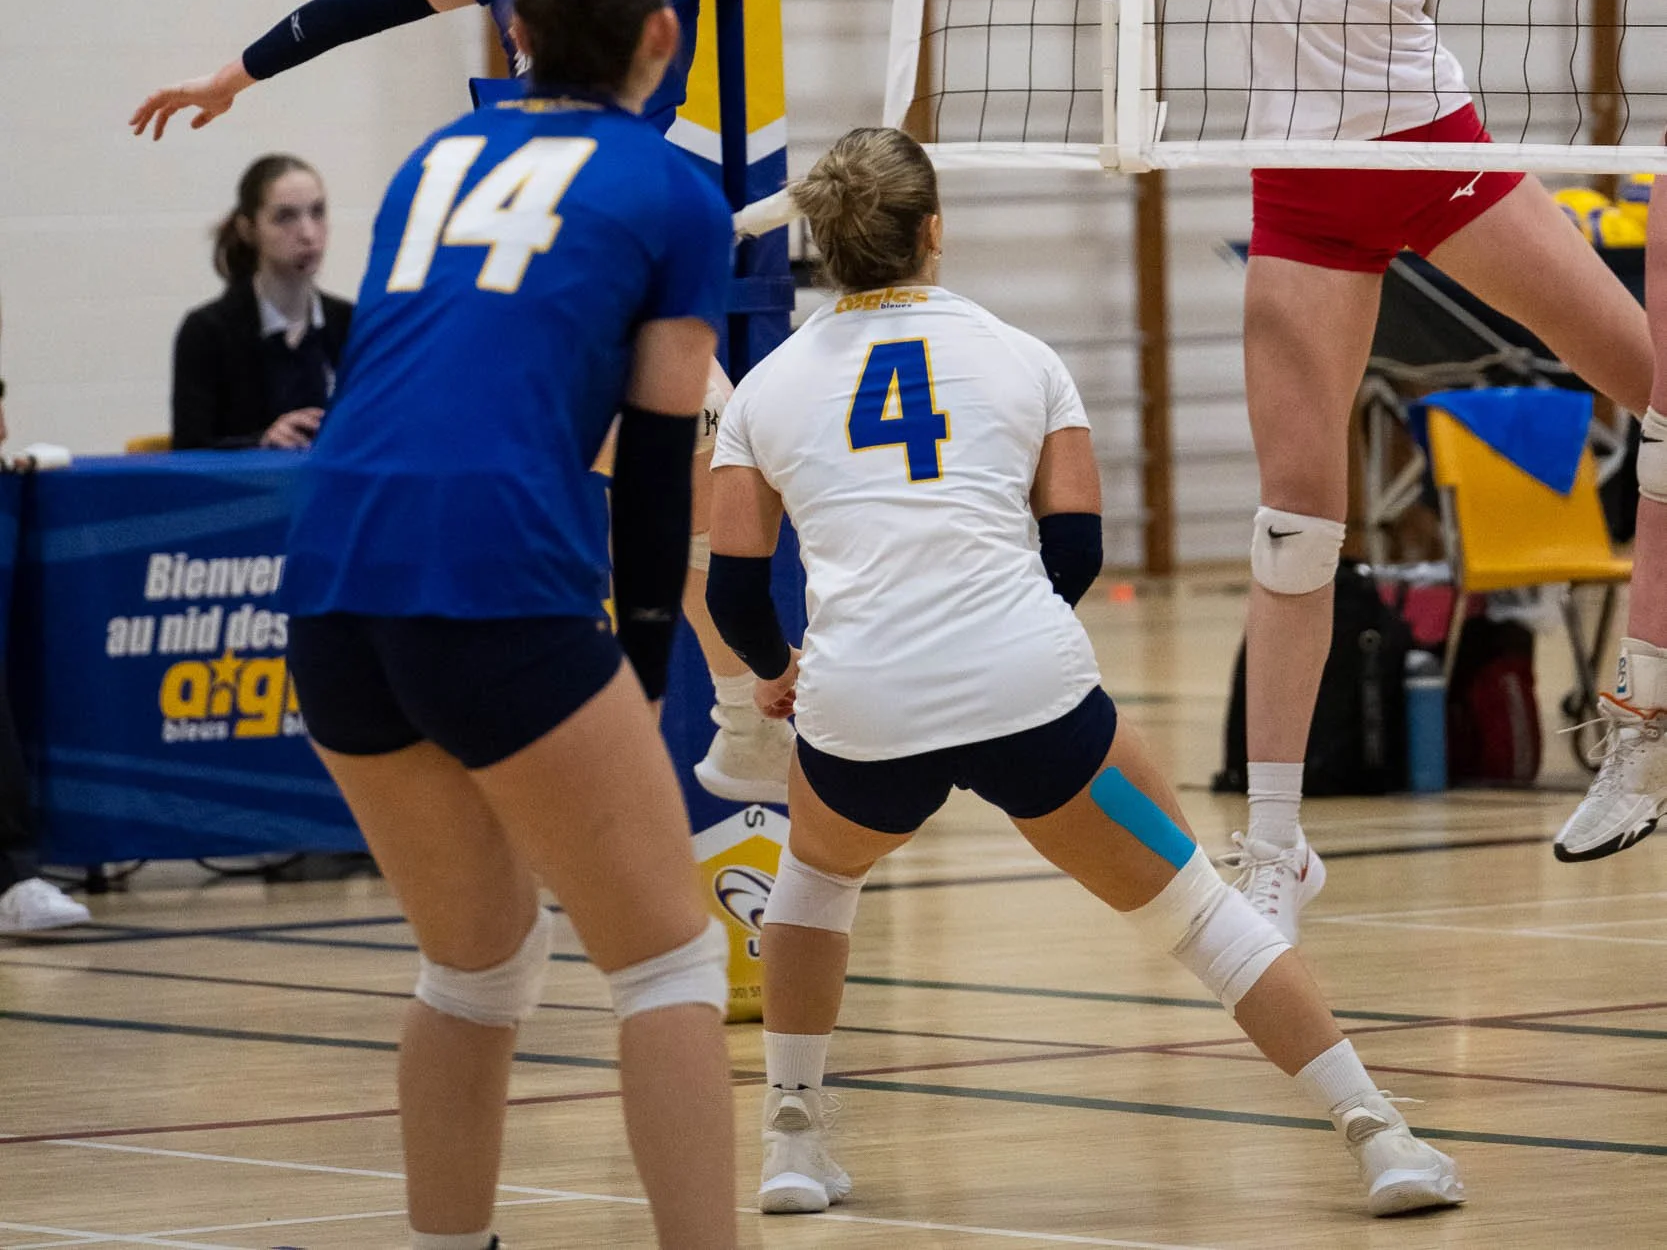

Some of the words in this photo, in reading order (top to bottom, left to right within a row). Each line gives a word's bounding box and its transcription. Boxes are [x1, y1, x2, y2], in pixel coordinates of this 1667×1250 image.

[386, 136, 597, 294] 14
[844, 337, 951, 484] 4
[107, 616, 155, 656] au
[159, 606, 223, 653] nid
[226, 604, 289, 648] des
[160, 651, 299, 738] aig
